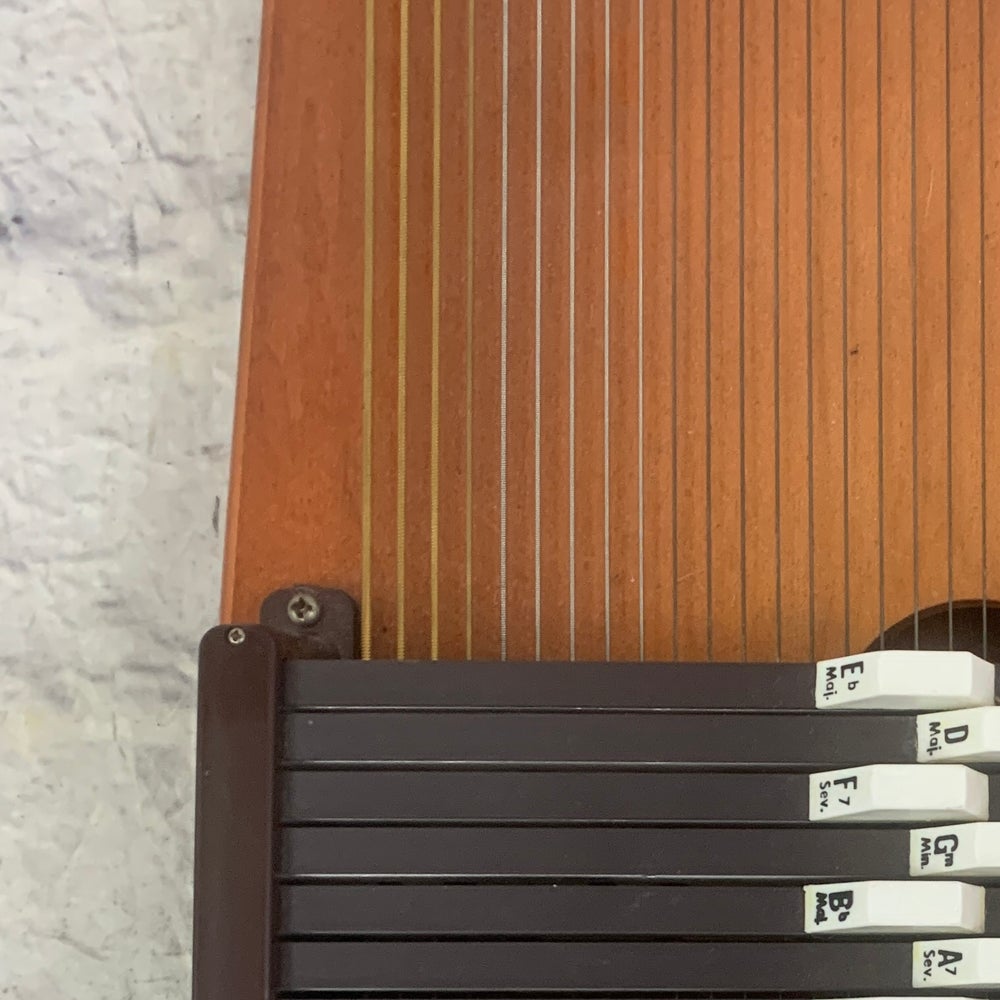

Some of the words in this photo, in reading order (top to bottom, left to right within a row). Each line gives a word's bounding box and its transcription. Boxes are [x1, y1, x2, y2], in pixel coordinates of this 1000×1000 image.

[944, 724, 969, 745] D
[819, 781, 831, 813] Sev.
[934, 834, 959, 867] Gm
[923, 950, 936, 982] Sev.
[938, 949, 963, 976] A7
